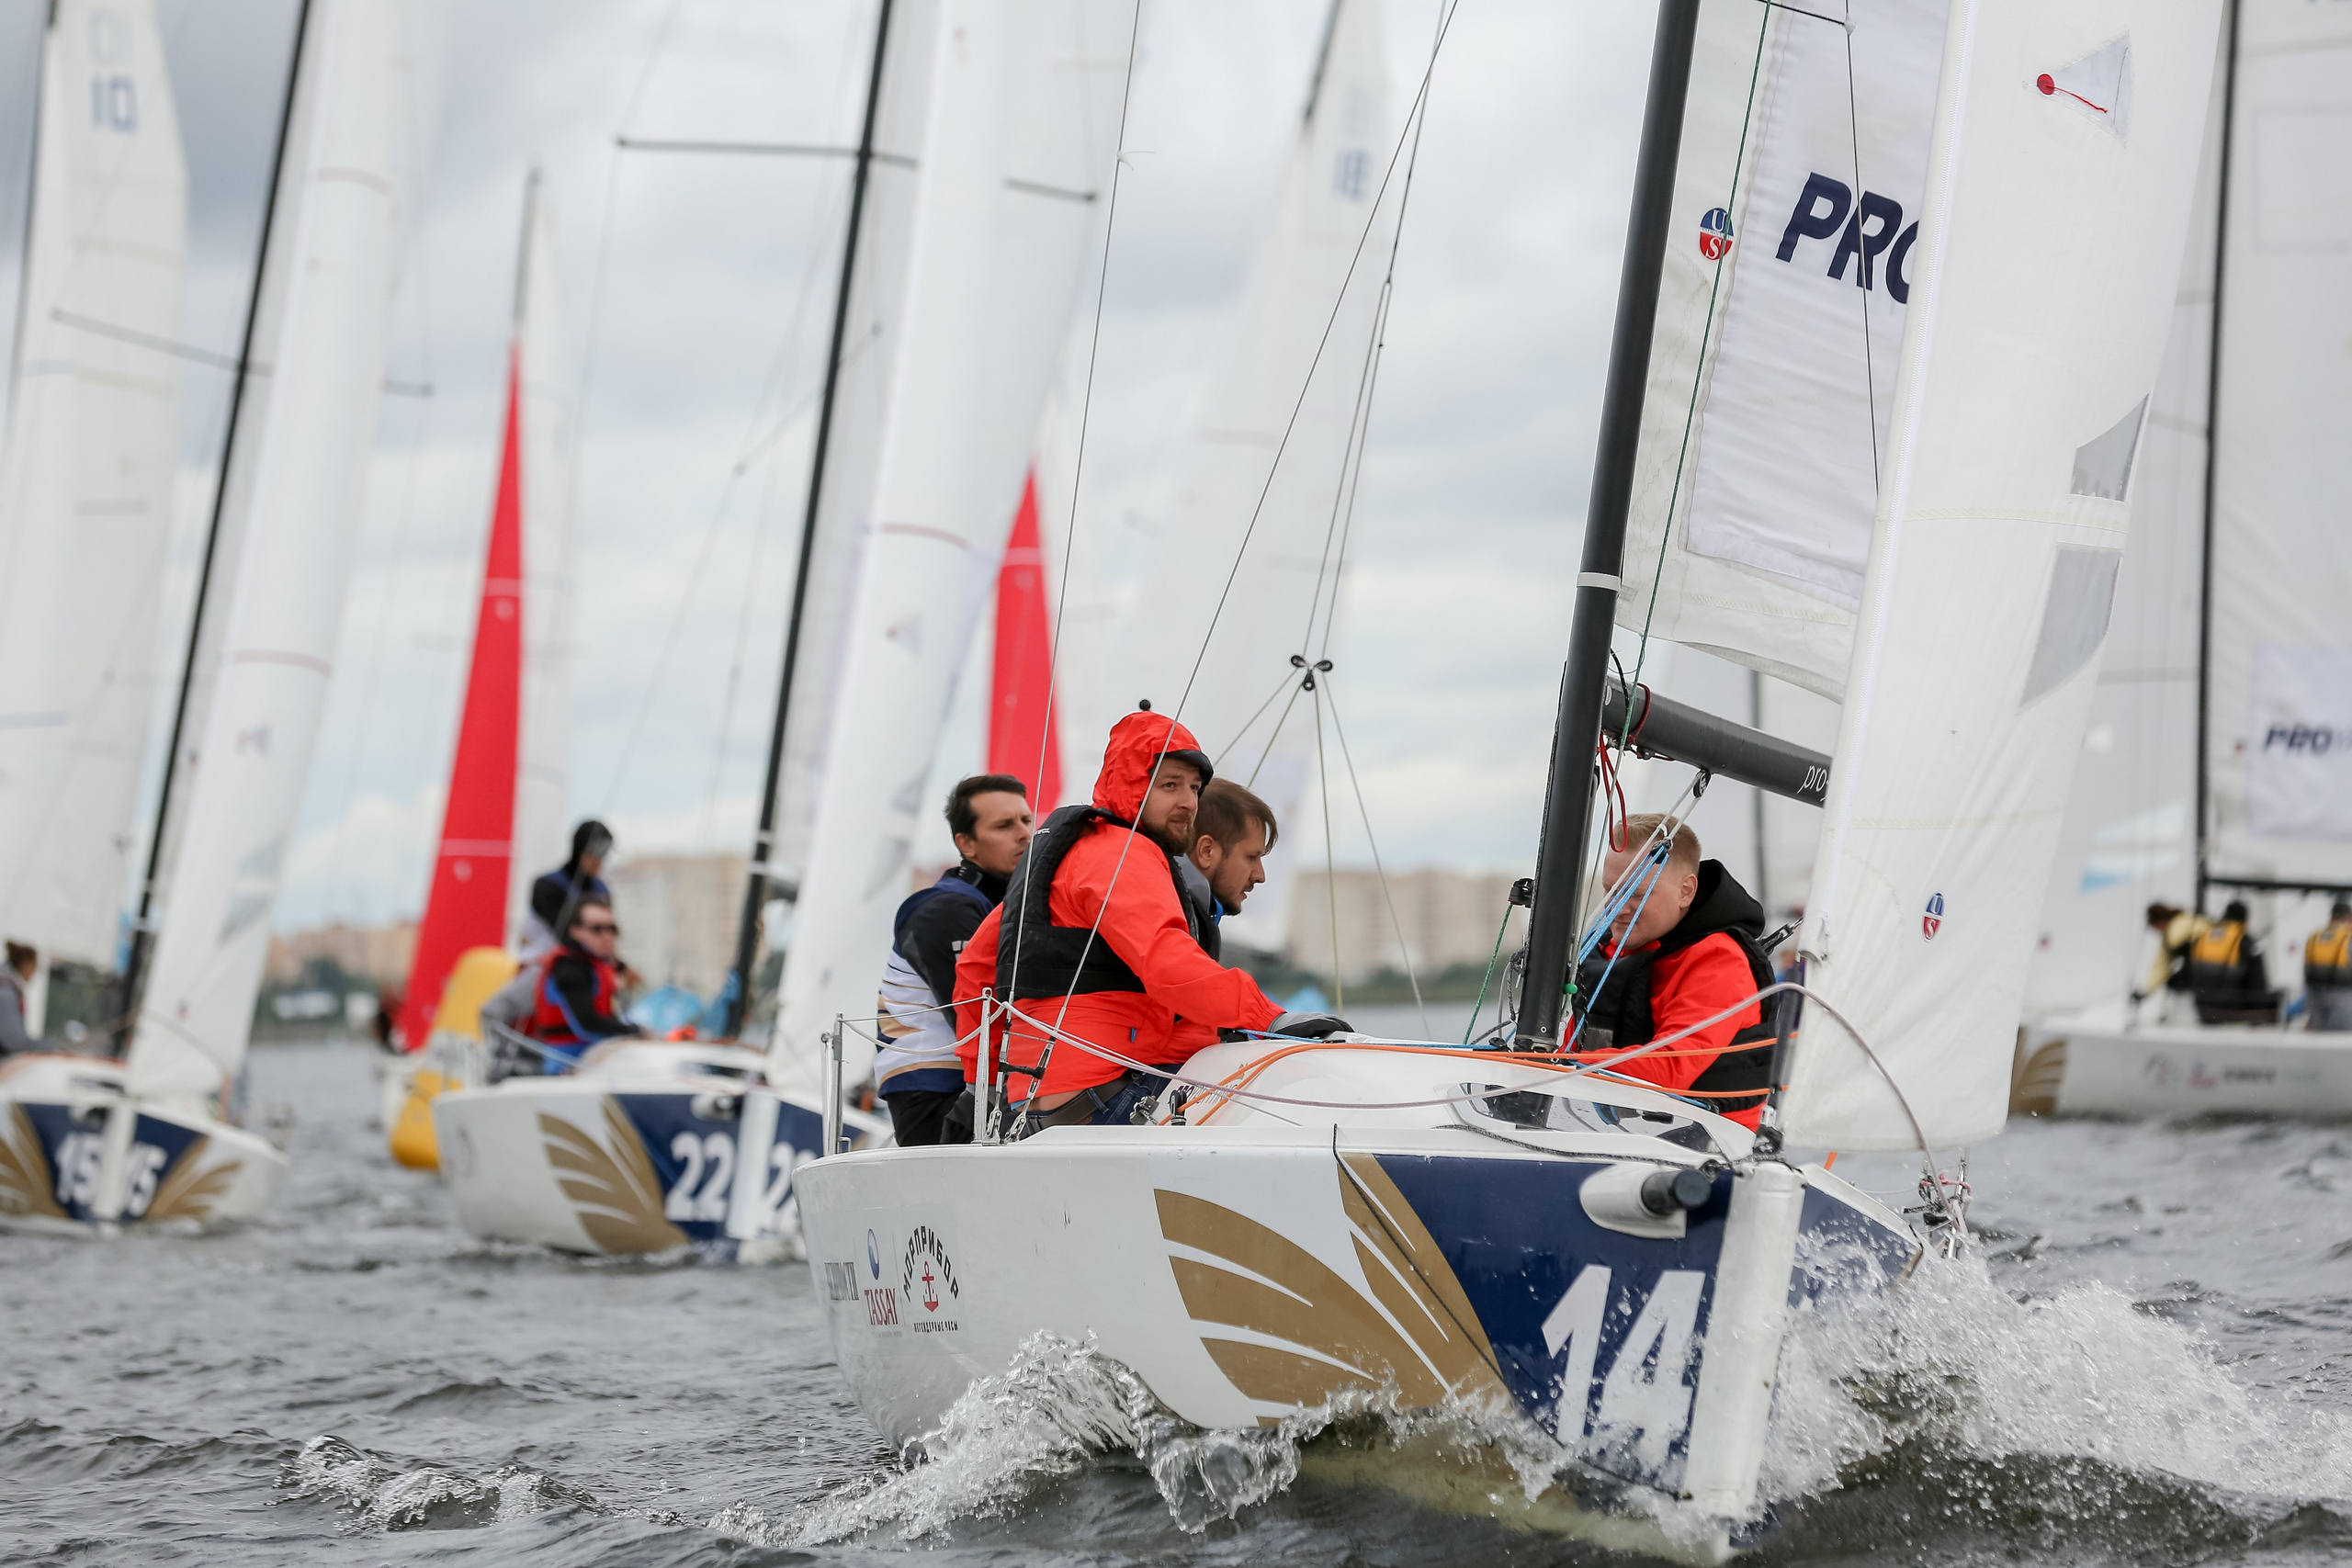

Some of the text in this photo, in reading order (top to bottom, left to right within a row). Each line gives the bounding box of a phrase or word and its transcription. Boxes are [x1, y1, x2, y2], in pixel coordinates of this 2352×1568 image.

[664, 1130, 735, 1223] 22
[903, 1225, 959, 1303] МОРПРИБОР
[865, 1288, 899, 1326] TASSAY
[1541, 1263, 1706, 1474] 14
